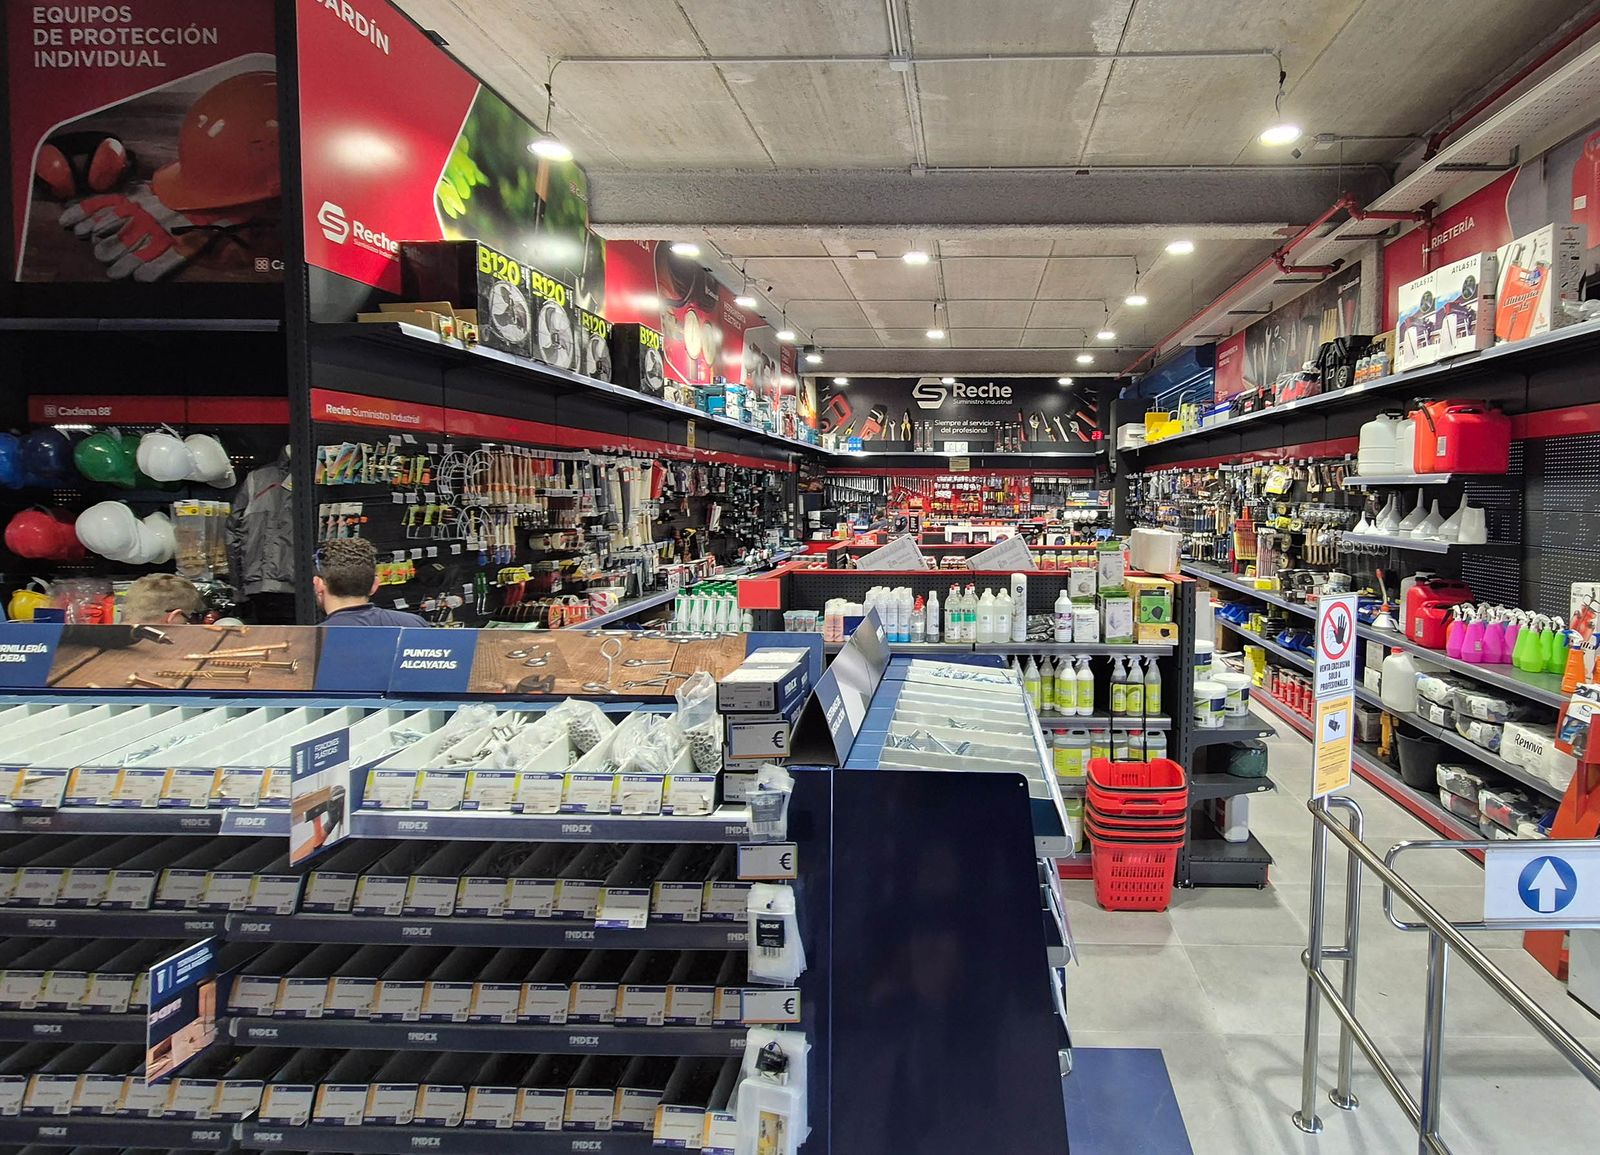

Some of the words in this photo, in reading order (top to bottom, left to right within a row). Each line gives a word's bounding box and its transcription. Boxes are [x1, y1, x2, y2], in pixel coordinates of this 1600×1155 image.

[33, 6, 132, 24] EQUIPOS
[316, 0, 389, 55] ARDÍN
[33, 29, 64, 46] DE
[70, 23, 218, 45] PROTECCIÓN
[34, 50, 166, 68] INDIVIDUAL
[353, 220, 399, 254] Reche
[1422, 215, 1475, 254] RRETERÍA
[478, 246, 521, 287] B120
[532, 271, 566, 307] B120
[582, 311, 607, 338] B120
[640, 327, 660, 350] B120
[953, 382, 1013, 398] Reche
[58, 406, 97, 416] Cadena
[98, 406, 111, 416] 88
[326, 404, 352, 416] Reche
[352, 408, 390, 421] Suministro
[390, 413, 420, 424] Industrial
[934, 420, 961, 428] Siempre
[1091, 431, 1103, 440] 23
[403, 649, 443, 658] PUNTAS
[443, 649, 452, 658] Y
[400, 661, 457, 670] ALCAYATAS
[1320, 663, 1331, 673] VENTA
[1331, 660, 1351, 671] EXCLUSIVA
[1328, 671, 1338, 681] SOLO
[1320, 679, 1349, 691] PROFESIONALES
[771, 730, 785, 749] €
[1514, 733, 1544, 756] Renova
[181, 818, 211, 826] INDEX
[235, 817, 266, 826] INDEX
[398, 821, 429, 830] INDEX
[561, 824, 592, 833] INDEX
[725, 826, 749, 835] INDE
[779, 853, 792, 870] €
[27, 919, 56, 928] INDEX
[184, 921, 214, 930] INDEX
[241, 923, 271, 932] INDEX
[402, 927, 432, 936] INDEX
[564, 930, 595, 940] INDEX
[727, 933, 749, 941] INDE
[783, 998, 796, 1015] €
[33, 1024, 63, 1033] INDEX
[249, 1028, 279, 1037] INDEX
[408, 1032, 437, 1041] INDEX
[569, 1036, 599, 1045] INDEX
[730, 1038, 747, 1047] IND
[38, 1127, 68, 1136] INDEX
[192, 1130, 221, 1140] INDEX
[253, 1132, 283, 1142] INDEX
[411, 1137, 441, 1146] INDEX
[572, 1140, 602, 1150] INDEX
